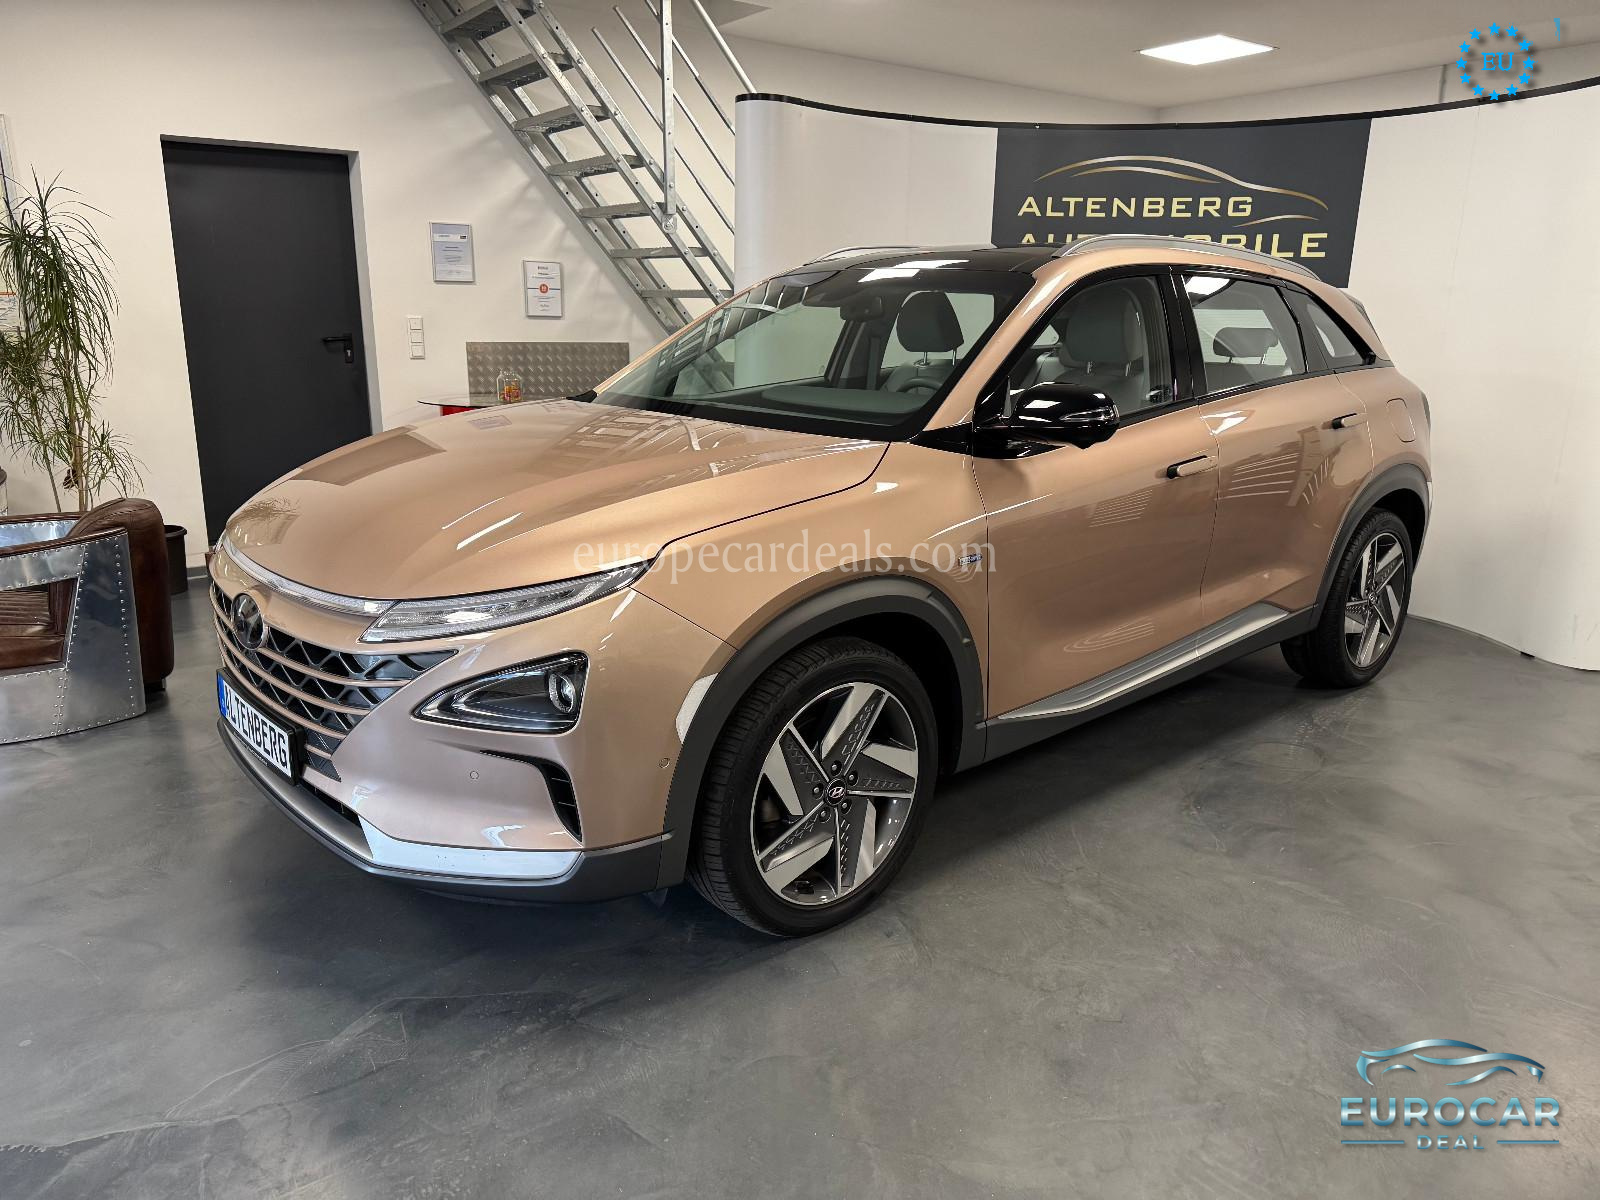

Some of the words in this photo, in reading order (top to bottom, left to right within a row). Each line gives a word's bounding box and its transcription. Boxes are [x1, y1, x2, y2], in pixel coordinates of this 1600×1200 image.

[1018, 196, 1253, 217] ALTENBERG
[1021, 232, 1328, 258] AUBILE
[224, 685, 288, 769] ALTENBERG
